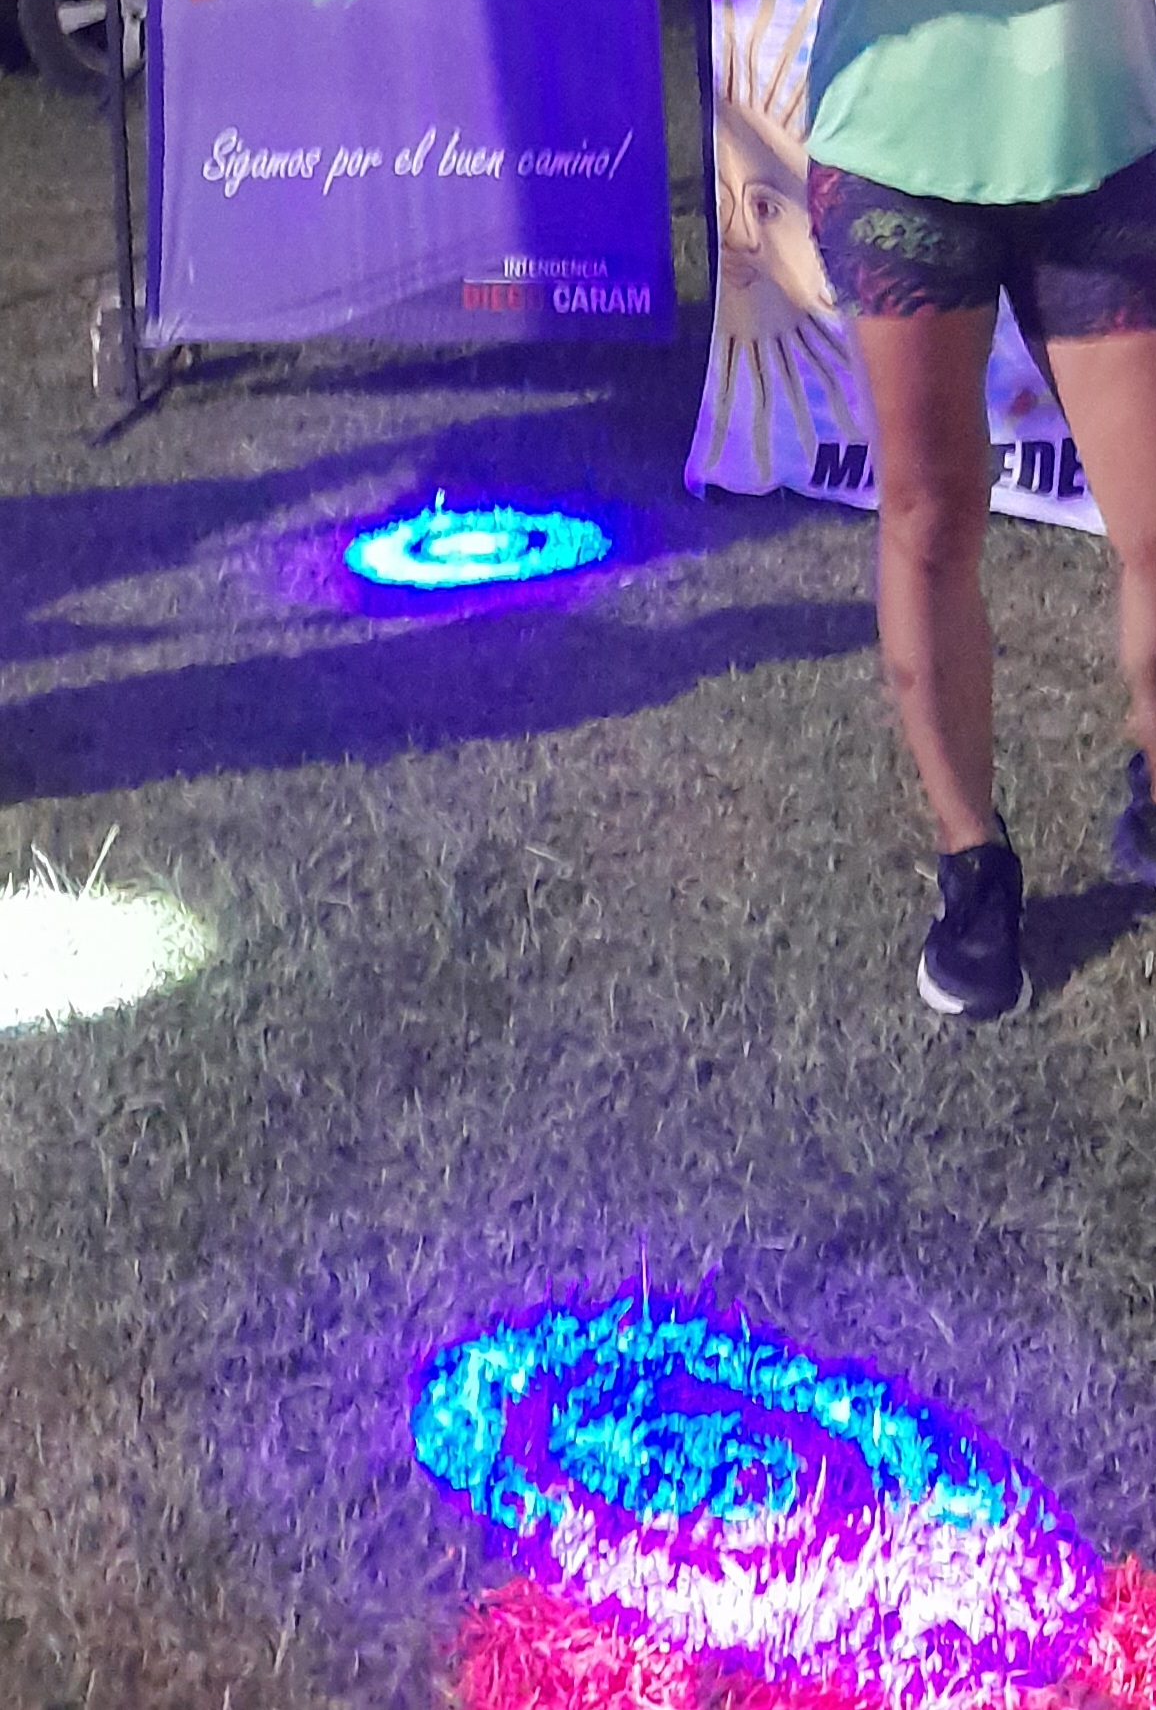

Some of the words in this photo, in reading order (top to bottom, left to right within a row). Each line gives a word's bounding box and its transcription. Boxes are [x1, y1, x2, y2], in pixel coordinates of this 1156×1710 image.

[203, 126, 321, 198] Sigamos
[322, 141, 383, 196] por
[394, 124, 437, 177] el
[438, 125, 506, 179] buen
[552, 282, 651, 315] CARAM
